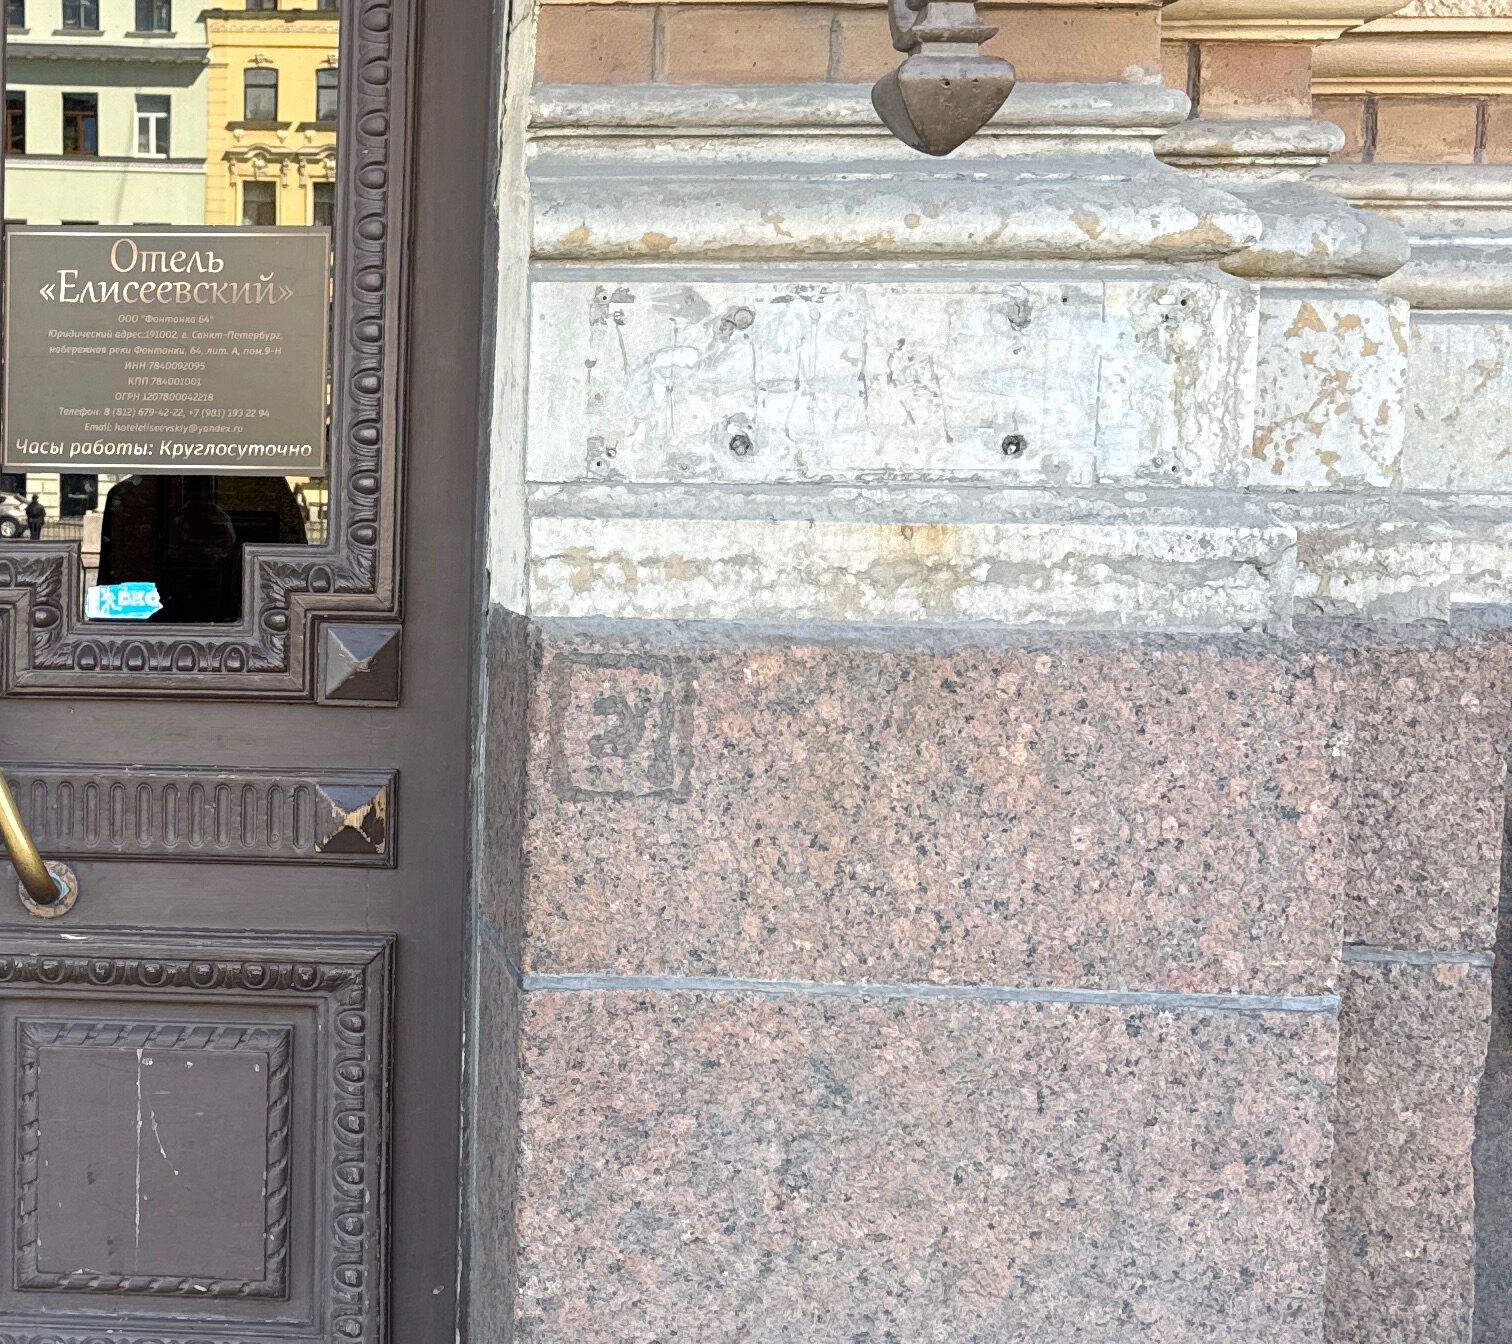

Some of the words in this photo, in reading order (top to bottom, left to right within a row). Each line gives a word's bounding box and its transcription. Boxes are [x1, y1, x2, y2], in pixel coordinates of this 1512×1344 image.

[109, 237, 225, 274] Отель
[39, 269, 295, 305] «Елисеевский»
[117, 314, 139, 324] ООО
[48, 329, 113, 340] Юридический
[191, 330, 284, 342] Санкт-Петербург,
[49, 344, 107, 355] набережная
[108, 346, 132, 356] реки
[124, 361, 147, 370] ИНН
[127, 376, 149, 386] КПП
[151, 377, 202, 387] 784001001
[114, 391, 141, 401] ОГРН
[103, 407, 111, 417] 8
[112, 407, 137, 418] (812)
[201, 407, 226, 419] (981)
[227, 408, 244, 418] 193
[245, 408, 257, 418] 22
[258, 409, 270, 418] 94
[84, 422, 112, 432] Email:
[15, 438, 65, 456] Часы
[69, 438, 155, 459] работы:
[159, 439, 313, 461] Круглосуточно
